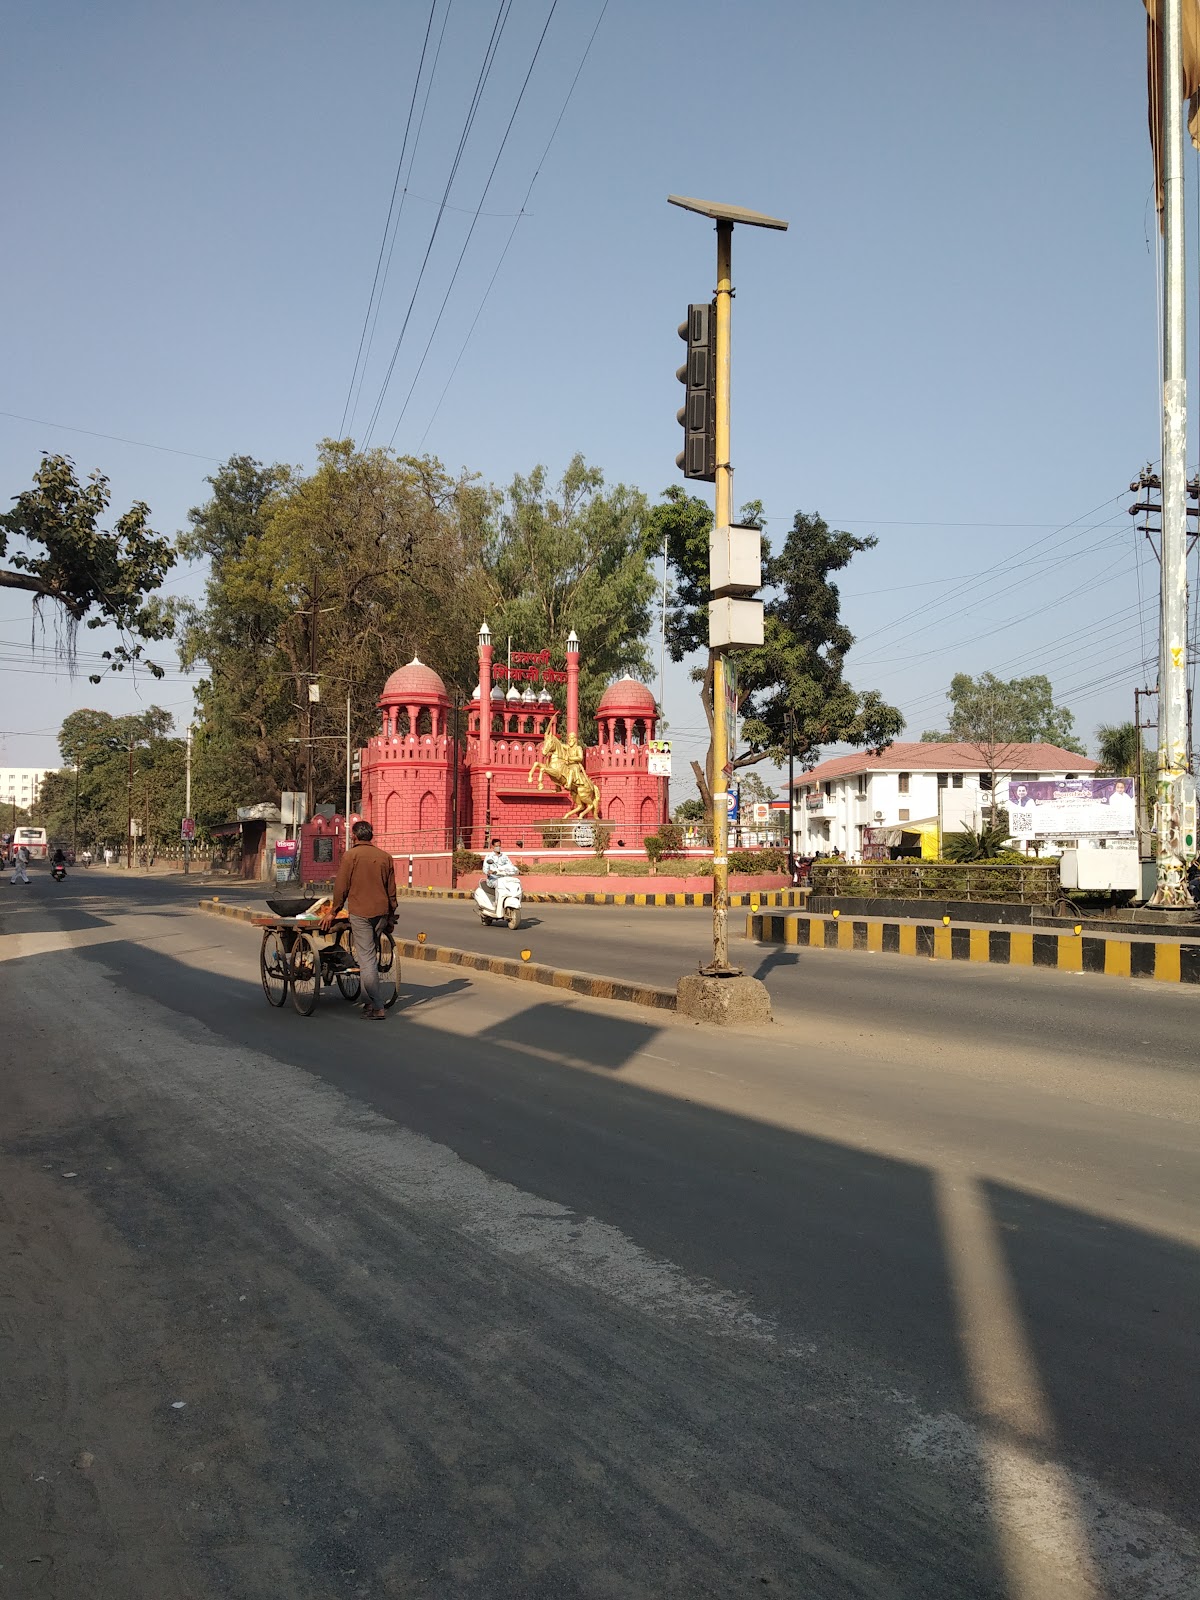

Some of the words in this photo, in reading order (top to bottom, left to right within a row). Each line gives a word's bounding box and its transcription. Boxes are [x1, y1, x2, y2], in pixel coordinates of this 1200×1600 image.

[510, 649, 551, 665] छत्रपती
[493, 663, 539, 682] शिवाजी
[542, 667, 568, 683] चौक
